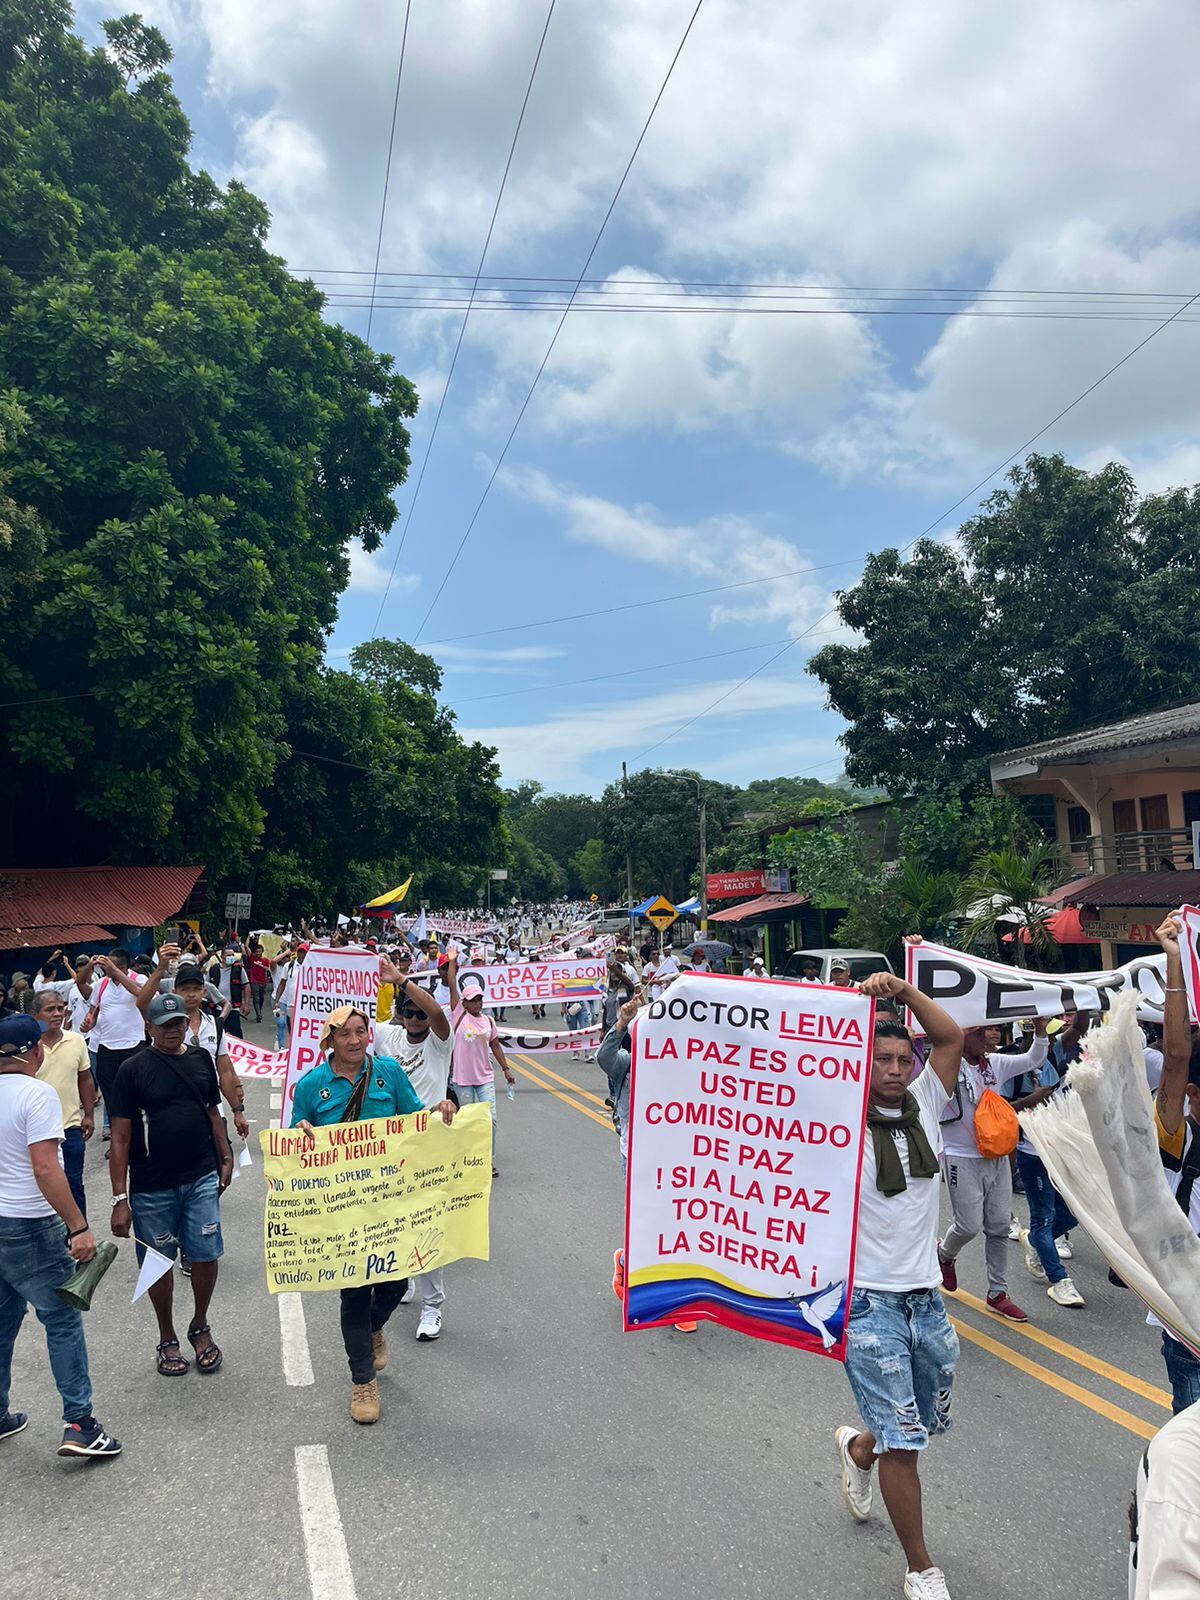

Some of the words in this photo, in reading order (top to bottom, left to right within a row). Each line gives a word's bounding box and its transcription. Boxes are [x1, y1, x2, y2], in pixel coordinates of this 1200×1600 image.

[724, 881, 756, 891] MADEY
[302, 966, 314, 991] LO
[316, 967, 380, 998] ESPERAMOS
[488, 974, 506, 986] LA
[508, 965, 548, 984] PAZ
[552, 969, 570, 981] ES
[575, 966, 606, 979] CON
[490, 983, 566, 1000] USTED
[648, 997, 770, 1031] DOCTOR
[779, 1011, 864, 1043] LEIVA
[554, 1040, 583, 1051] DE
[644, 1038, 679, 1060] LA
[686, 1038, 741, 1068] PAZ
[749, 1047, 787, 1073] ES
[797, 1054, 862, 1083] CON
[700, 1071, 796, 1108] USTED
[329, 1123, 377, 1147] URGENTE
[386, 1118, 404, 1135] POR
[416, 1113, 428, 1132] LA
[645, 1101, 851, 1149] COMISIONADO
[299, 1148, 339, 1169] SIERRA
[345, 1139, 386, 1161] NEVADA
[693, 1134, 730, 1162] DE
[739, 1144, 794, 1175] PAZ
[291, 1176, 331, 1191] PODEMOS
[335, 1168, 374, 1184] ESPERAR
[671, 1166, 696, 1189] SI
[703, 1169, 722, 1193] A
[730, 1174, 764, 1204] LA
[773, 1184, 831, 1214] PAZ
[950, 1164, 958, 1188] NIKE
[672, 1198, 757, 1236] TOTAL
[766, 1216, 806, 1245] EN
[657, 1231, 691, 1256] LA
[698, 1230, 802, 1279] SIERRA
